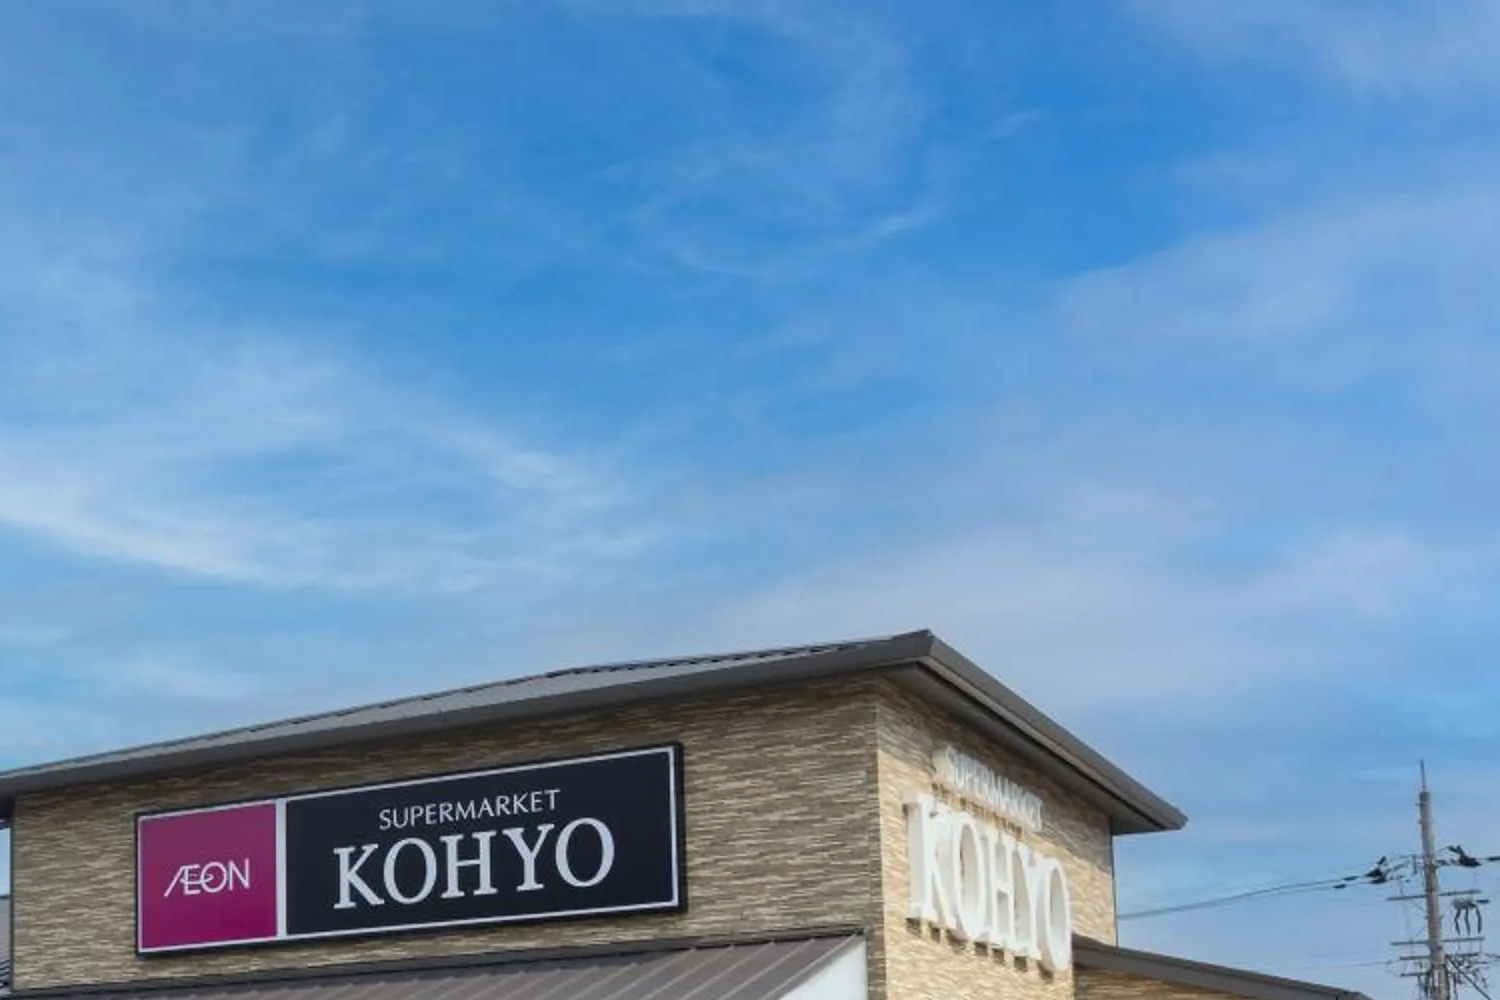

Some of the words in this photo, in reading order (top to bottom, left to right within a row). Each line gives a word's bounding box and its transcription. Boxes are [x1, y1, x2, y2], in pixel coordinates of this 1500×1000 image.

[379, 788, 561, 831] SUPERMARKET
[333, 817, 616, 909] KOHYO
[902, 793, 1072, 971] KOHYO
